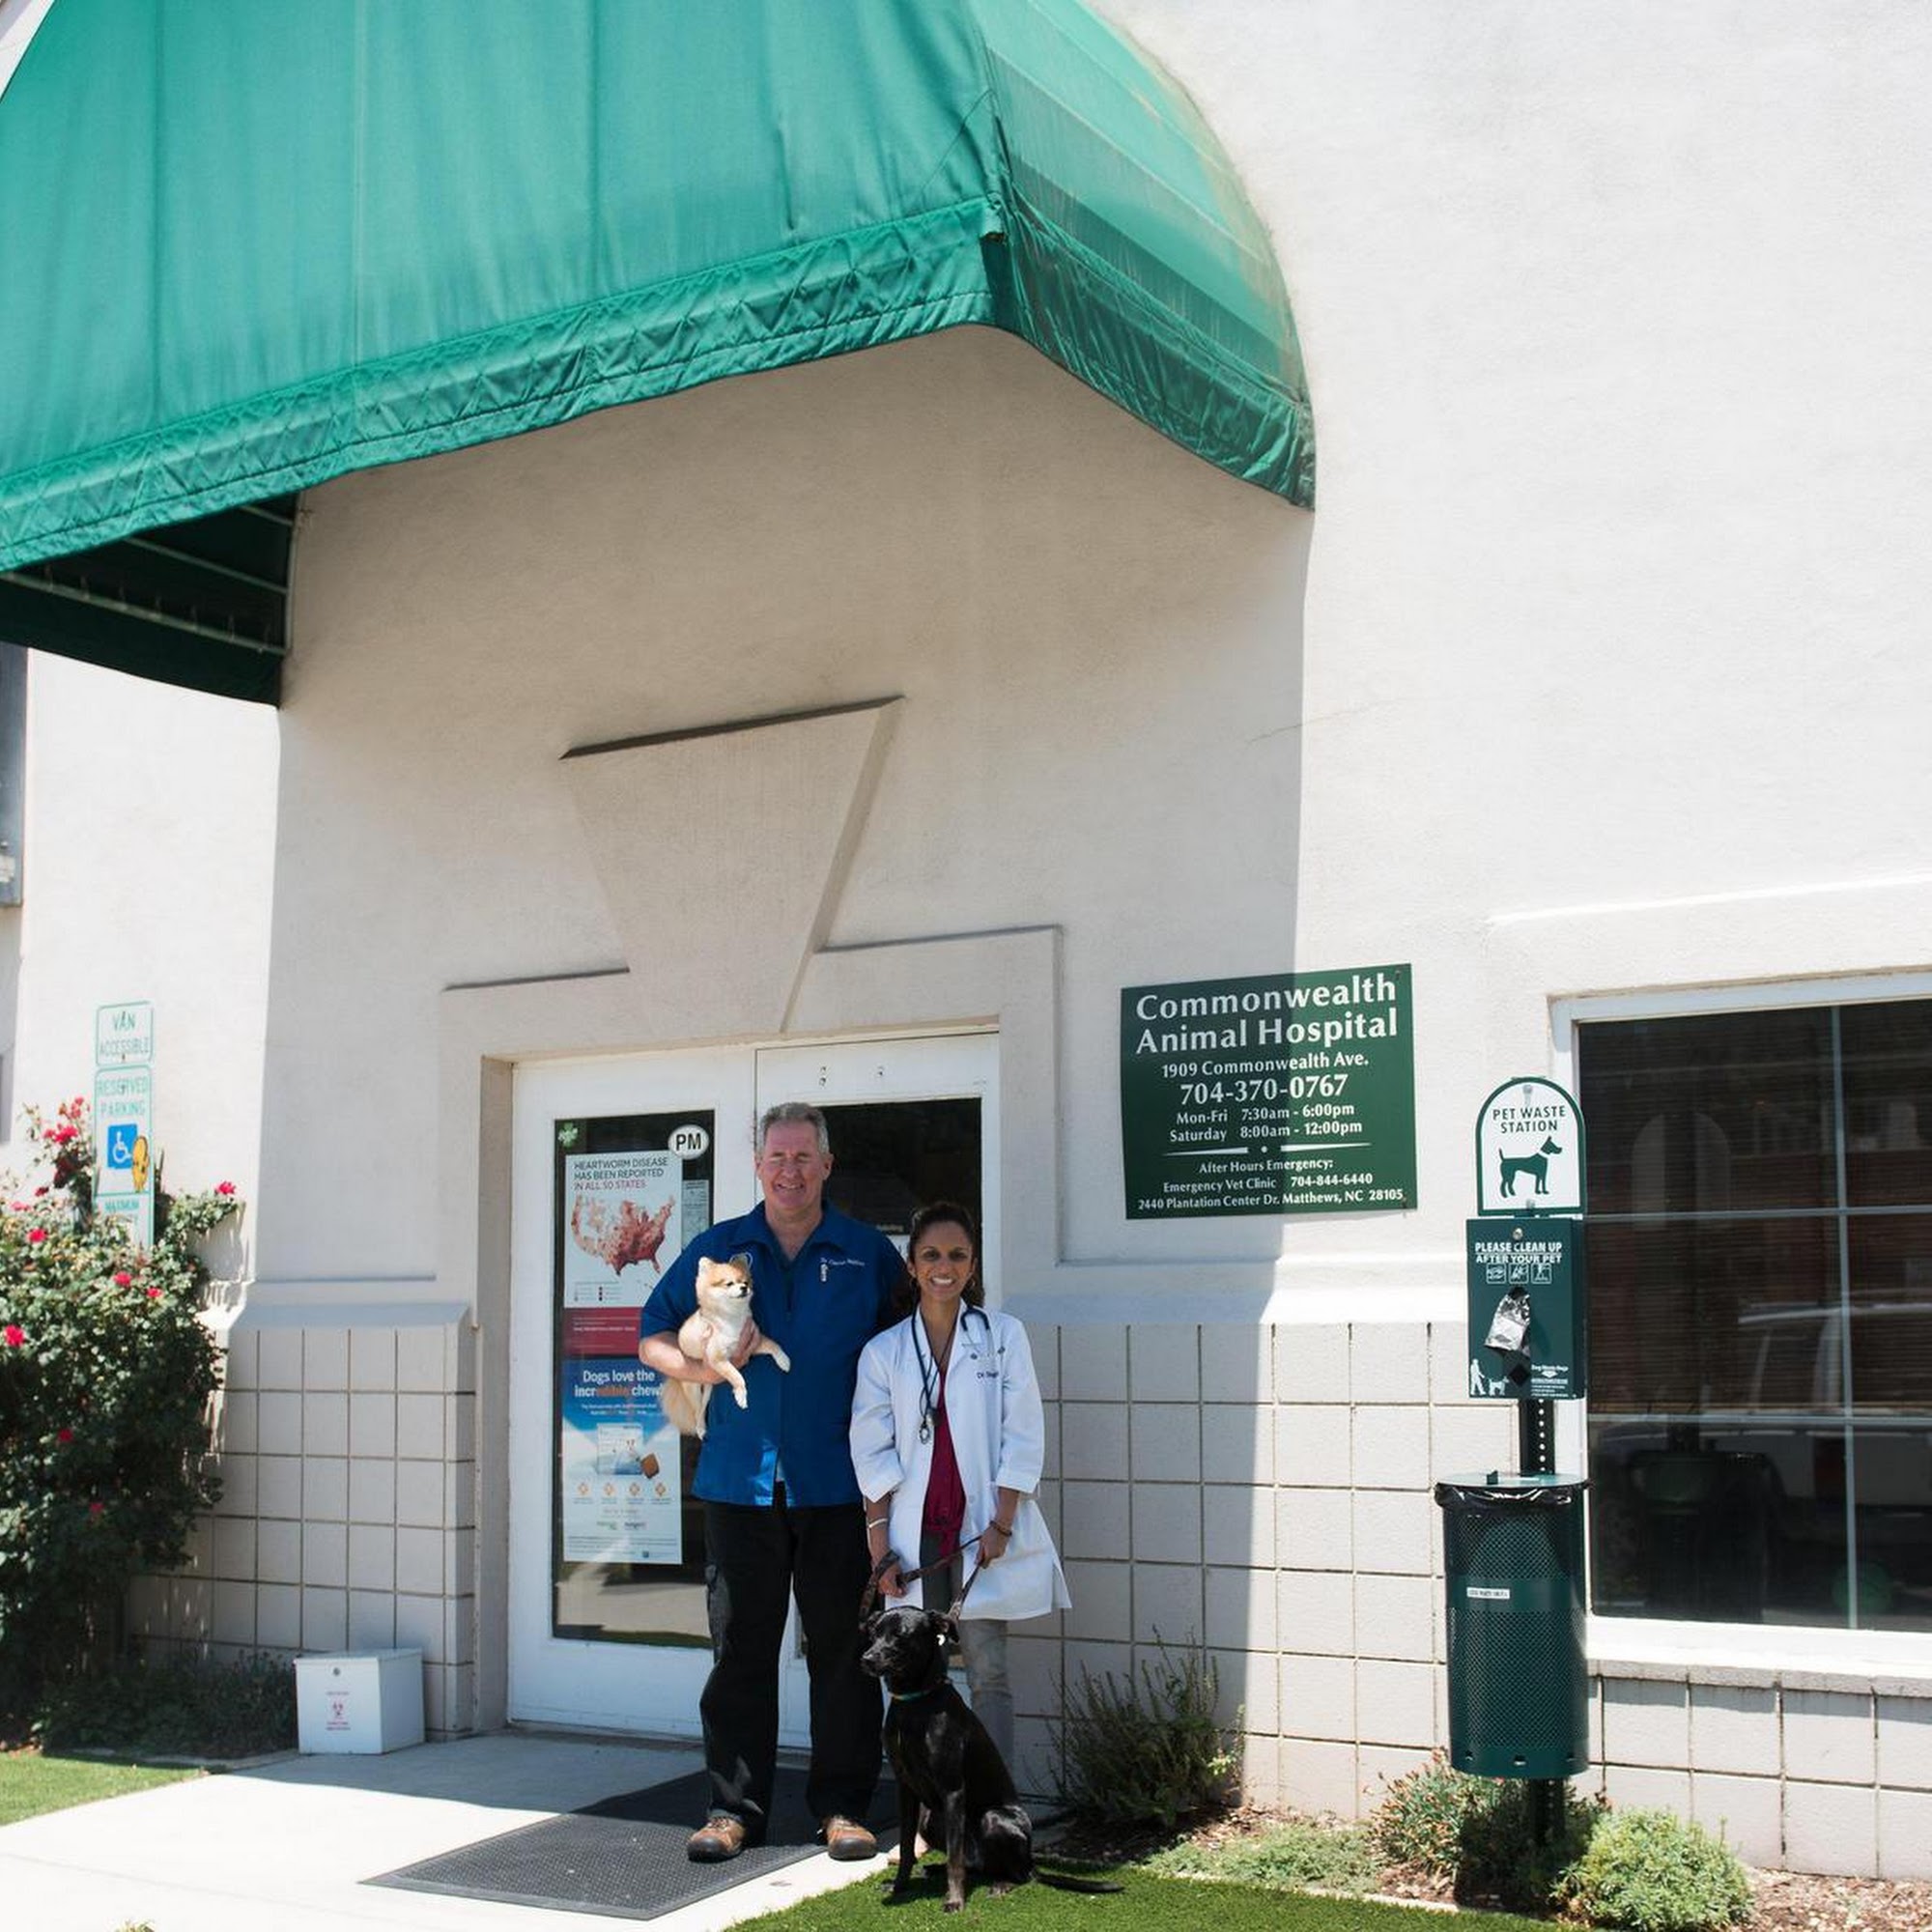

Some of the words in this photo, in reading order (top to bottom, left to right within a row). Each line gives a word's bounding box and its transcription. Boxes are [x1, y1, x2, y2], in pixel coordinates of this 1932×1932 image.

[1136, 973, 1396, 1020] Commonwealth
[113, 1011, 135, 1031] VAN
[1136, 1019, 1246, 1054] Animal
[1259, 1007, 1397, 1047] Hospital
[99, 1037, 149, 1055] ACCESSIBLE
[1162, 1063, 1198, 1077] 1909
[1202, 1051, 1329, 1075] Commonwealth
[1334, 1051, 1369, 1067] Ave.
[98, 1076, 148, 1095] RESERVED
[1180, 1074, 1349, 1105] 704-370-0767
[100, 1100, 146, 1119] PARKING
[1177, 1109, 1228, 1124] Mon-Fri
[1241, 1107, 1290, 1121] 7:30am
[1302, 1103, 1354, 1119] 6:00pm
[1492, 1108, 1516, 1121] PET
[1520, 1105, 1566, 1119] WASTE
[1170, 1127, 1227, 1142] Saturday
[1240, 1124, 1291, 1138] 8:00am
[1304, 1121, 1363, 1136] 12:00pm
[1500, 1120, 1557, 1133] STATION
[676, 1133, 701, 1151] PM
[574, 1159, 631, 1170] HEARTWORM
[632, 1157, 668, 1167] DISEASE
[1199, 1162, 1228, 1174] After
[1230, 1160, 1264, 1173] Hours
[1266, 1159, 1333, 1172] Emergency:
[574, 1171, 592, 1180] HAS
[593, 1170, 616, 1179] BEEN
[617, 1168, 664, 1179] REPORTED
[584, 1180, 603, 1190] ALL
[1163, 1180, 1223, 1194] Emergency
[1225, 1179, 1243, 1190] Vet
[1246, 1177, 1276, 1189] Clinic
[1291, 1173, 1374, 1187] 704-844-6440
[1138, 1199, 1164, 1209] 2440
[1166, 1197, 1221, 1208] Plantation
[1223, 1195, 1260, 1207] Center
[1264, 1194, 1280, 1205] Dr.
[1282, 1191, 1343, 1204] Matthews,
[1345, 1190, 1364, 1202] NC
[1369, 1189, 1404, 1201] 28105
[1475, 1241, 1512, 1252] PLEASE
[1514, 1241, 1546, 1252] CLEAN
[1548, 1241, 1562, 1252] UP
[1476, 1254, 1509, 1264] AFTER
[1511, 1254, 1540, 1264] YOUR
[1543, 1254, 1562, 1264] PET
[582, 1370, 610, 1384] Dogs
[612, 1369, 635, 1381] love
[637, 1369, 655, 1381] the
